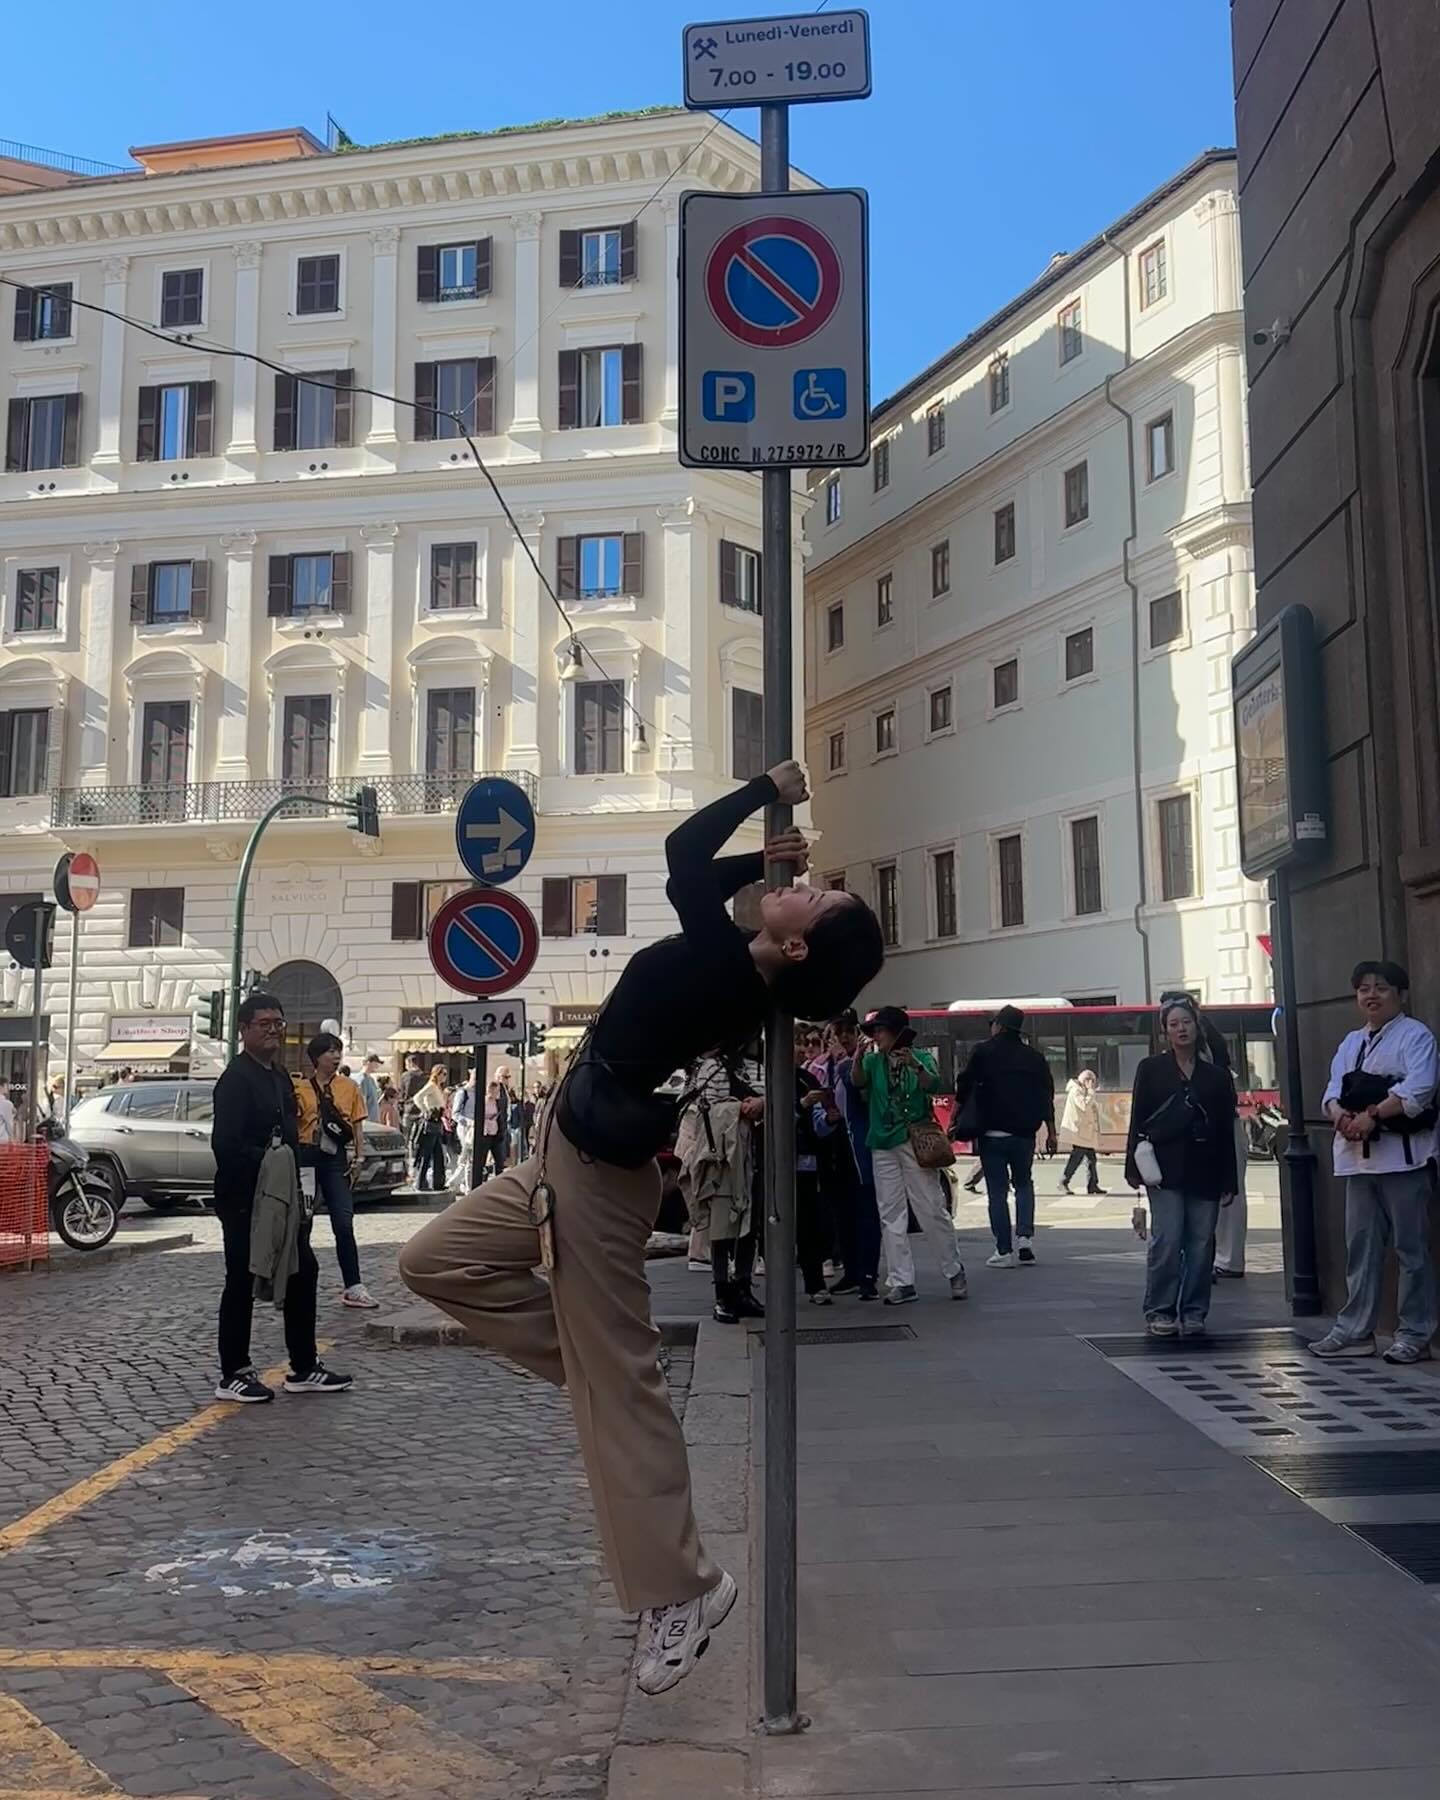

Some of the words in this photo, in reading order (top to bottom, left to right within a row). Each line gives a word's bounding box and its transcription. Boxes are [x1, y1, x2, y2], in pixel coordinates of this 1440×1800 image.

[709, 68, 757, 87] 7.00
[784, 61, 846, 82] 19.00
[715, 377, 746, 416] P
[700, 446, 740, 461] CONC
